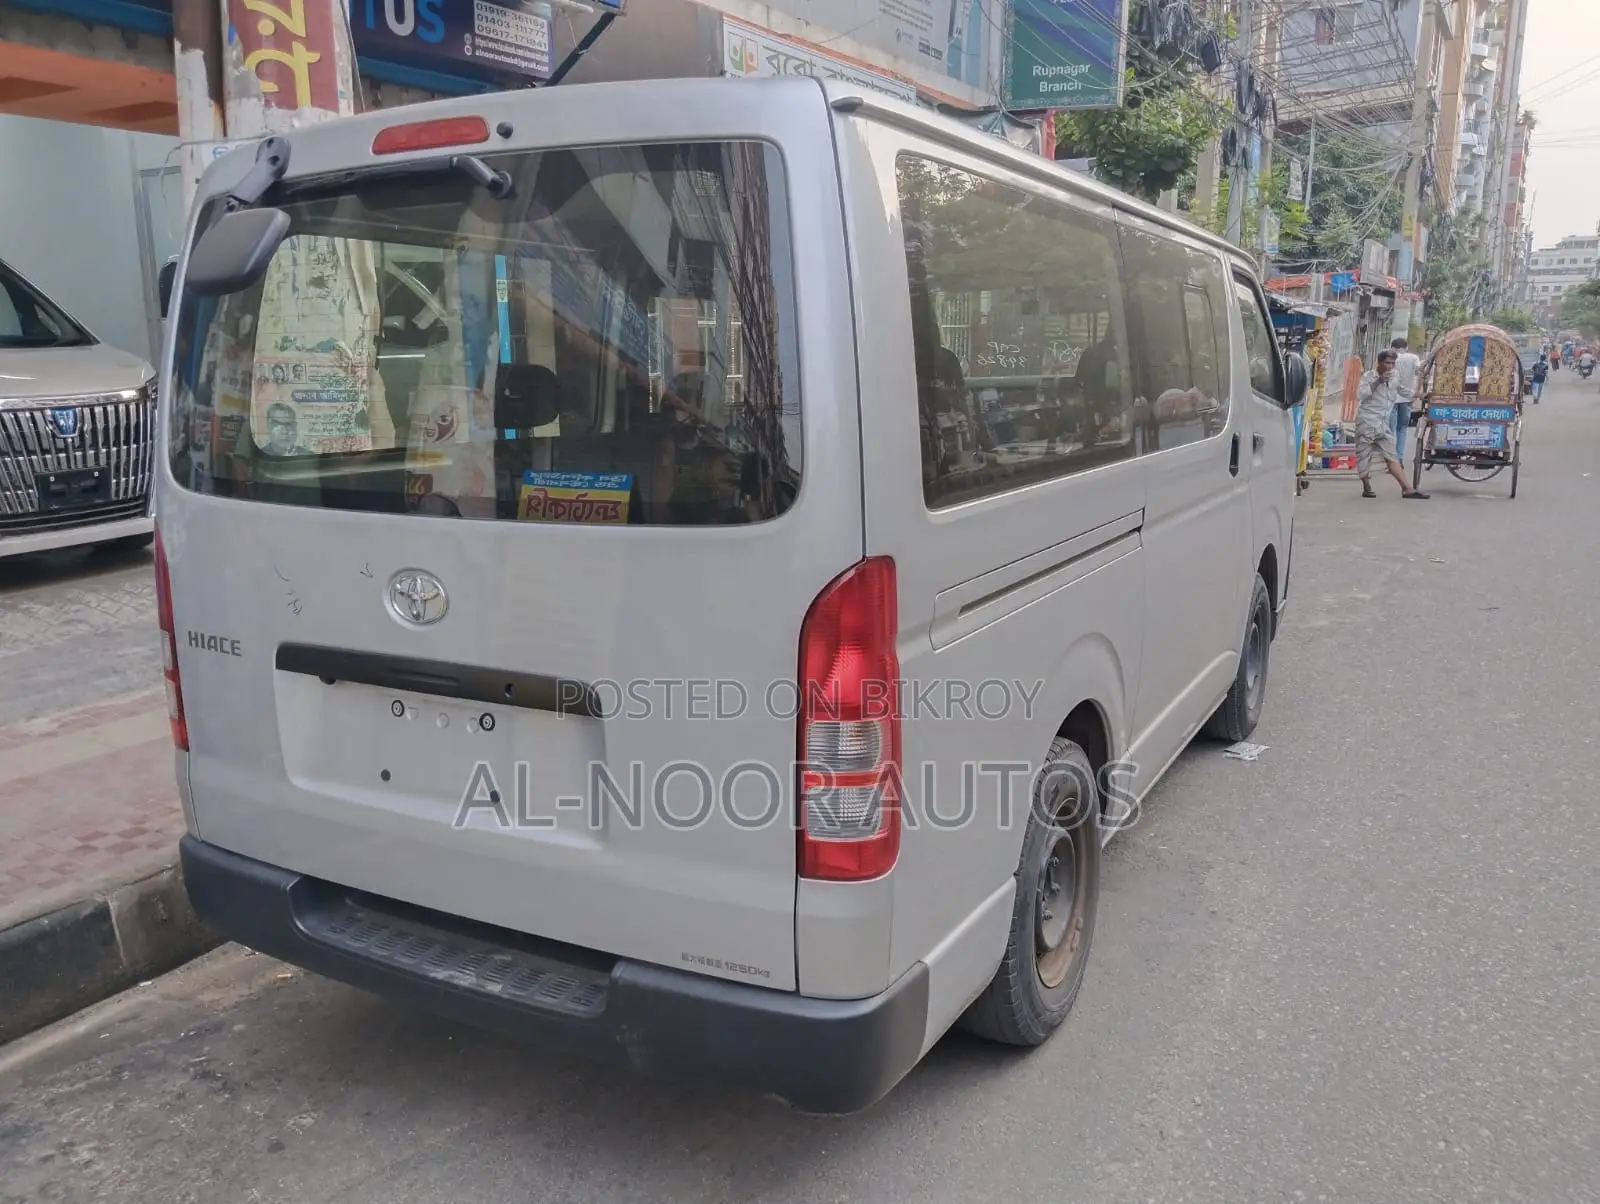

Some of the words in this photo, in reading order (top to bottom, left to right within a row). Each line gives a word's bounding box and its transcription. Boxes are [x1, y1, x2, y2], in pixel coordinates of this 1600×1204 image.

[1032, 63, 1091, 78] Rupnagar
[1039, 80, 1082, 93] Branch
[187, 630, 242, 657] HIACE
